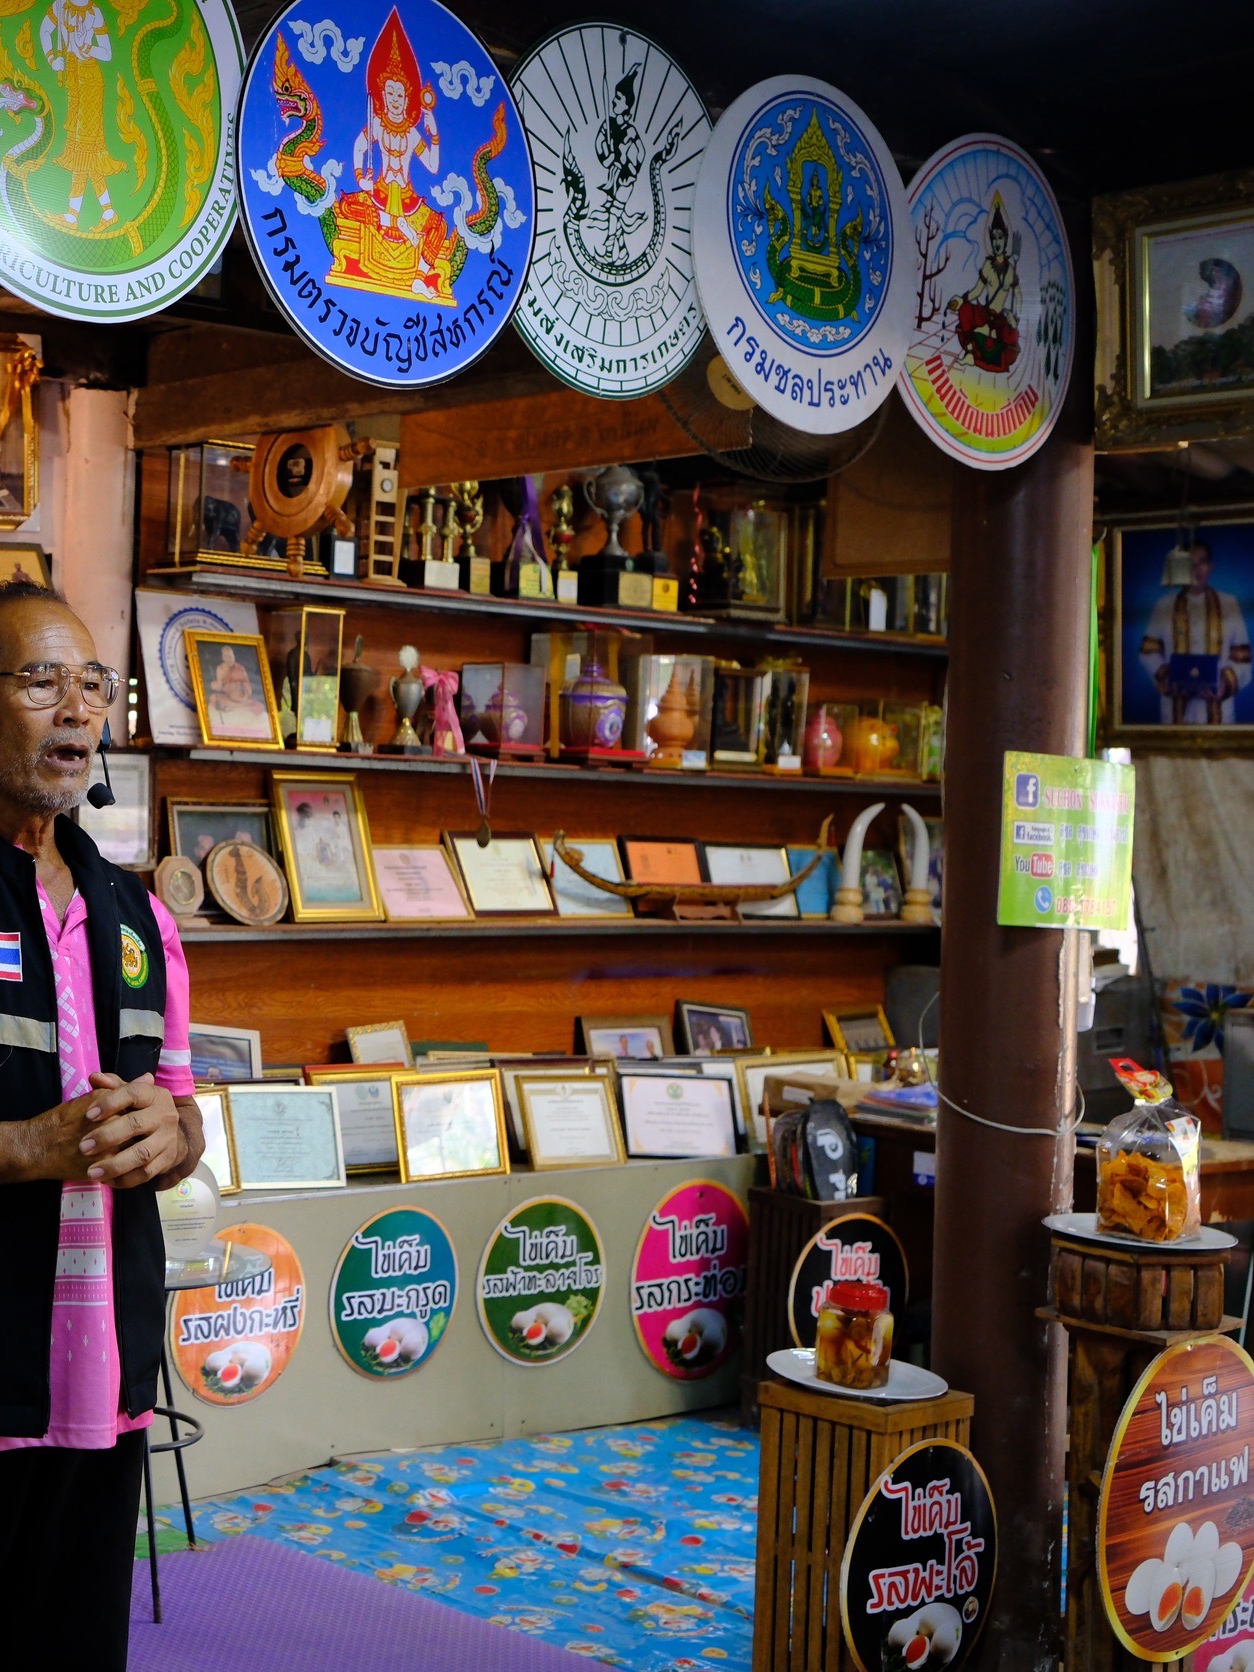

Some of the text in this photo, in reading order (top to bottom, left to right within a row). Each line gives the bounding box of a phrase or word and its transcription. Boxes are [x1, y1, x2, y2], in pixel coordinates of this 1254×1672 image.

[125, 271, 167, 303] AND
[261, 207, 514, 374] กรมตรวจบัญชีสหกรณ์
[524, 282, 698, 375] รมส่งเสริมการเกษตร
[726, 316, 893, 408] กรมชลประทาน
[354, 1234, 430, 1276] ไข่เค็ม
[503, 1224, 577, 1265] ไข่เค็ม
[654, 1214, 726, 1261] ไข่เค็ม
[343, 1282, 450, 1320] รสมะกรูด
[1157, 1379, 1239, 1447] ไข่เค็ม
[885, 1481, 959, 1537] ไข่เค็ม
[1140, 1444, 1250, 1513] รสกาแฟ
[869, 1524, 984, 1611] รสพะโล้
